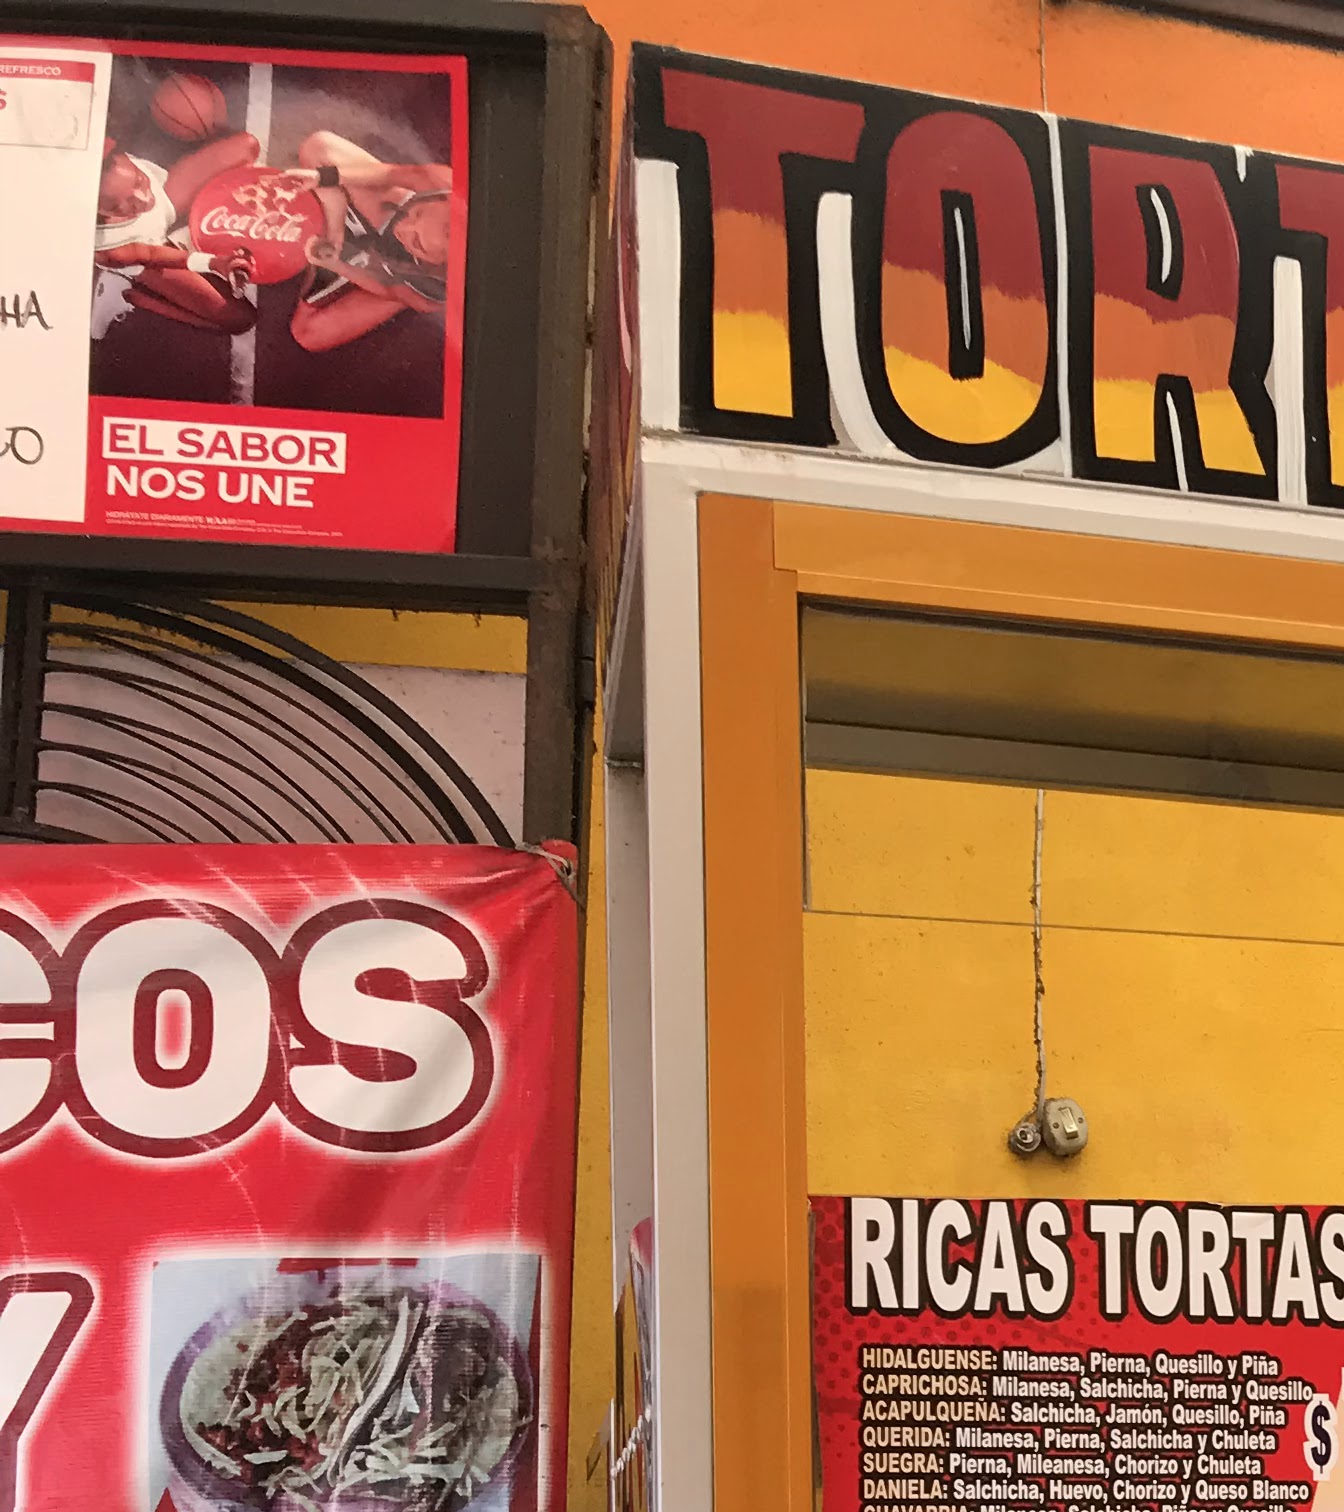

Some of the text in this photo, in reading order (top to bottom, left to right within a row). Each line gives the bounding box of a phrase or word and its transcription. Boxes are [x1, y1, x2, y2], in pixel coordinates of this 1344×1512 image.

[109, 424, 338, 467] EL SABOR
[106, 466, 314, 507] NOS UNE
[851, 1197, 1069, 1314] RICAS
[863, 1348, 1278, 1379] HIDALGUENSE: Milanesa, Pierna, Quesillo y Piña
[862, 1374, 1312, 1403] CAPRICHOSA: Milanesa, Salchicha, Pierna y Quesillo
[862, 1398, 1285, 1428] ACAPULQUEÑA: Salchicha, Jamón, Quesillo, Piña
[863, 1453, 1261, 1478] SUEGRA: Pierna, Mileanesa, Chorizo y Chuleta
